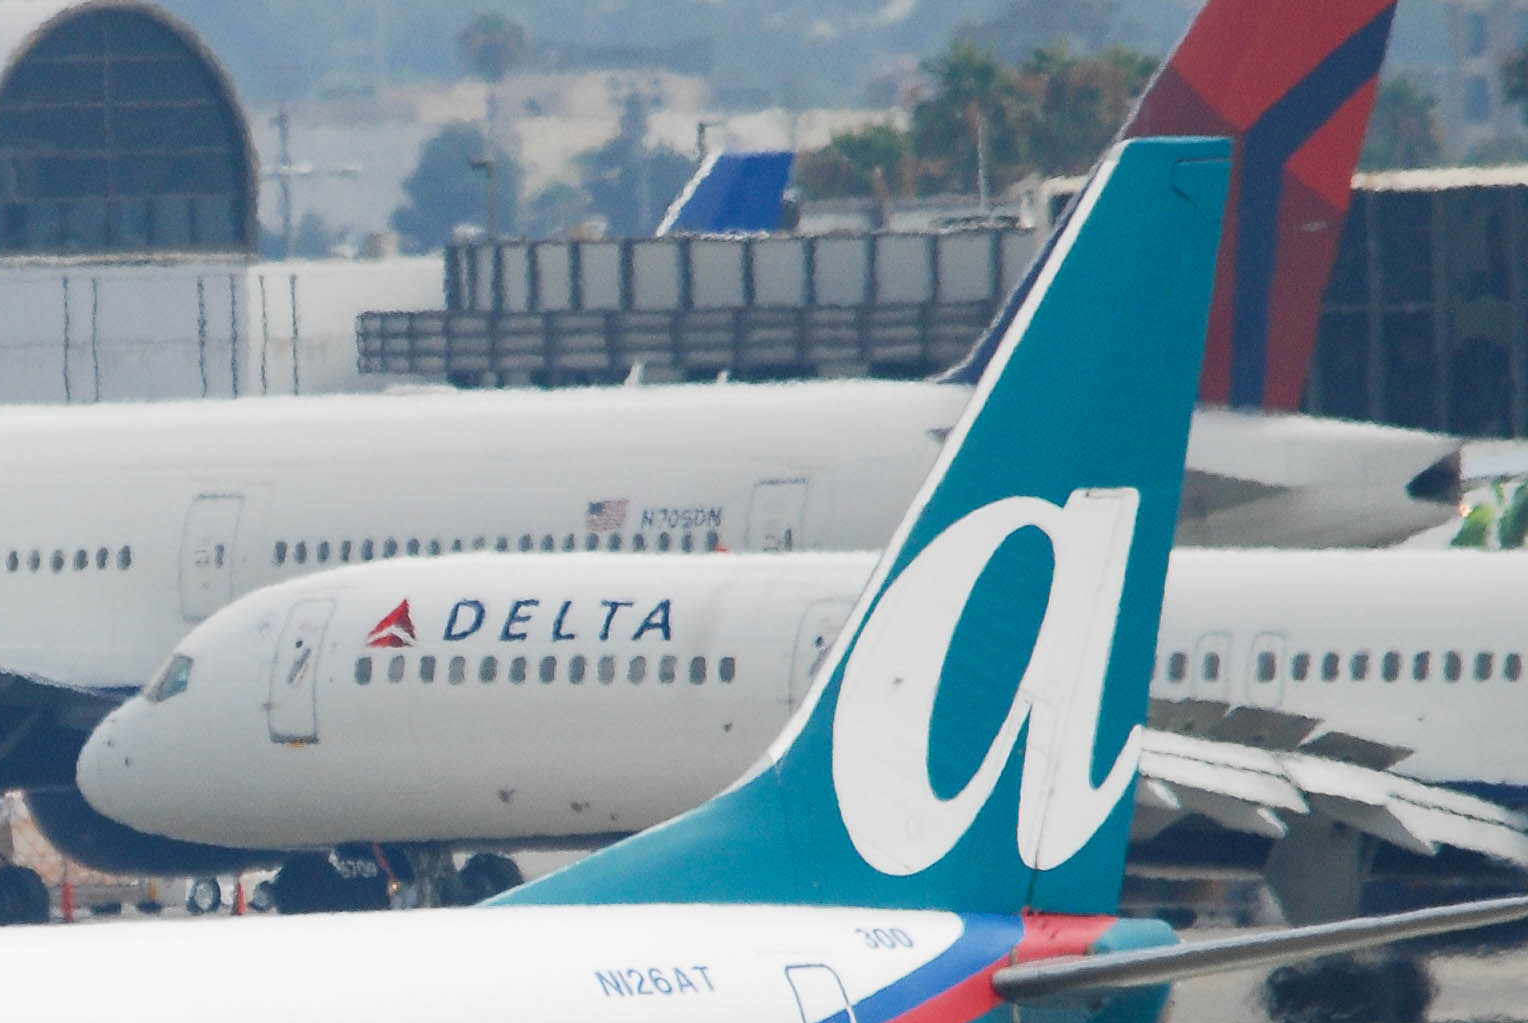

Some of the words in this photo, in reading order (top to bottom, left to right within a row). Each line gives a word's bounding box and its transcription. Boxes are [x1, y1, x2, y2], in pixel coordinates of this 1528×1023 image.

[443, 599, 671, 641] DELTA
[854, 928, 914, 949] 300
[595, 965, 715, 997] N126AT
